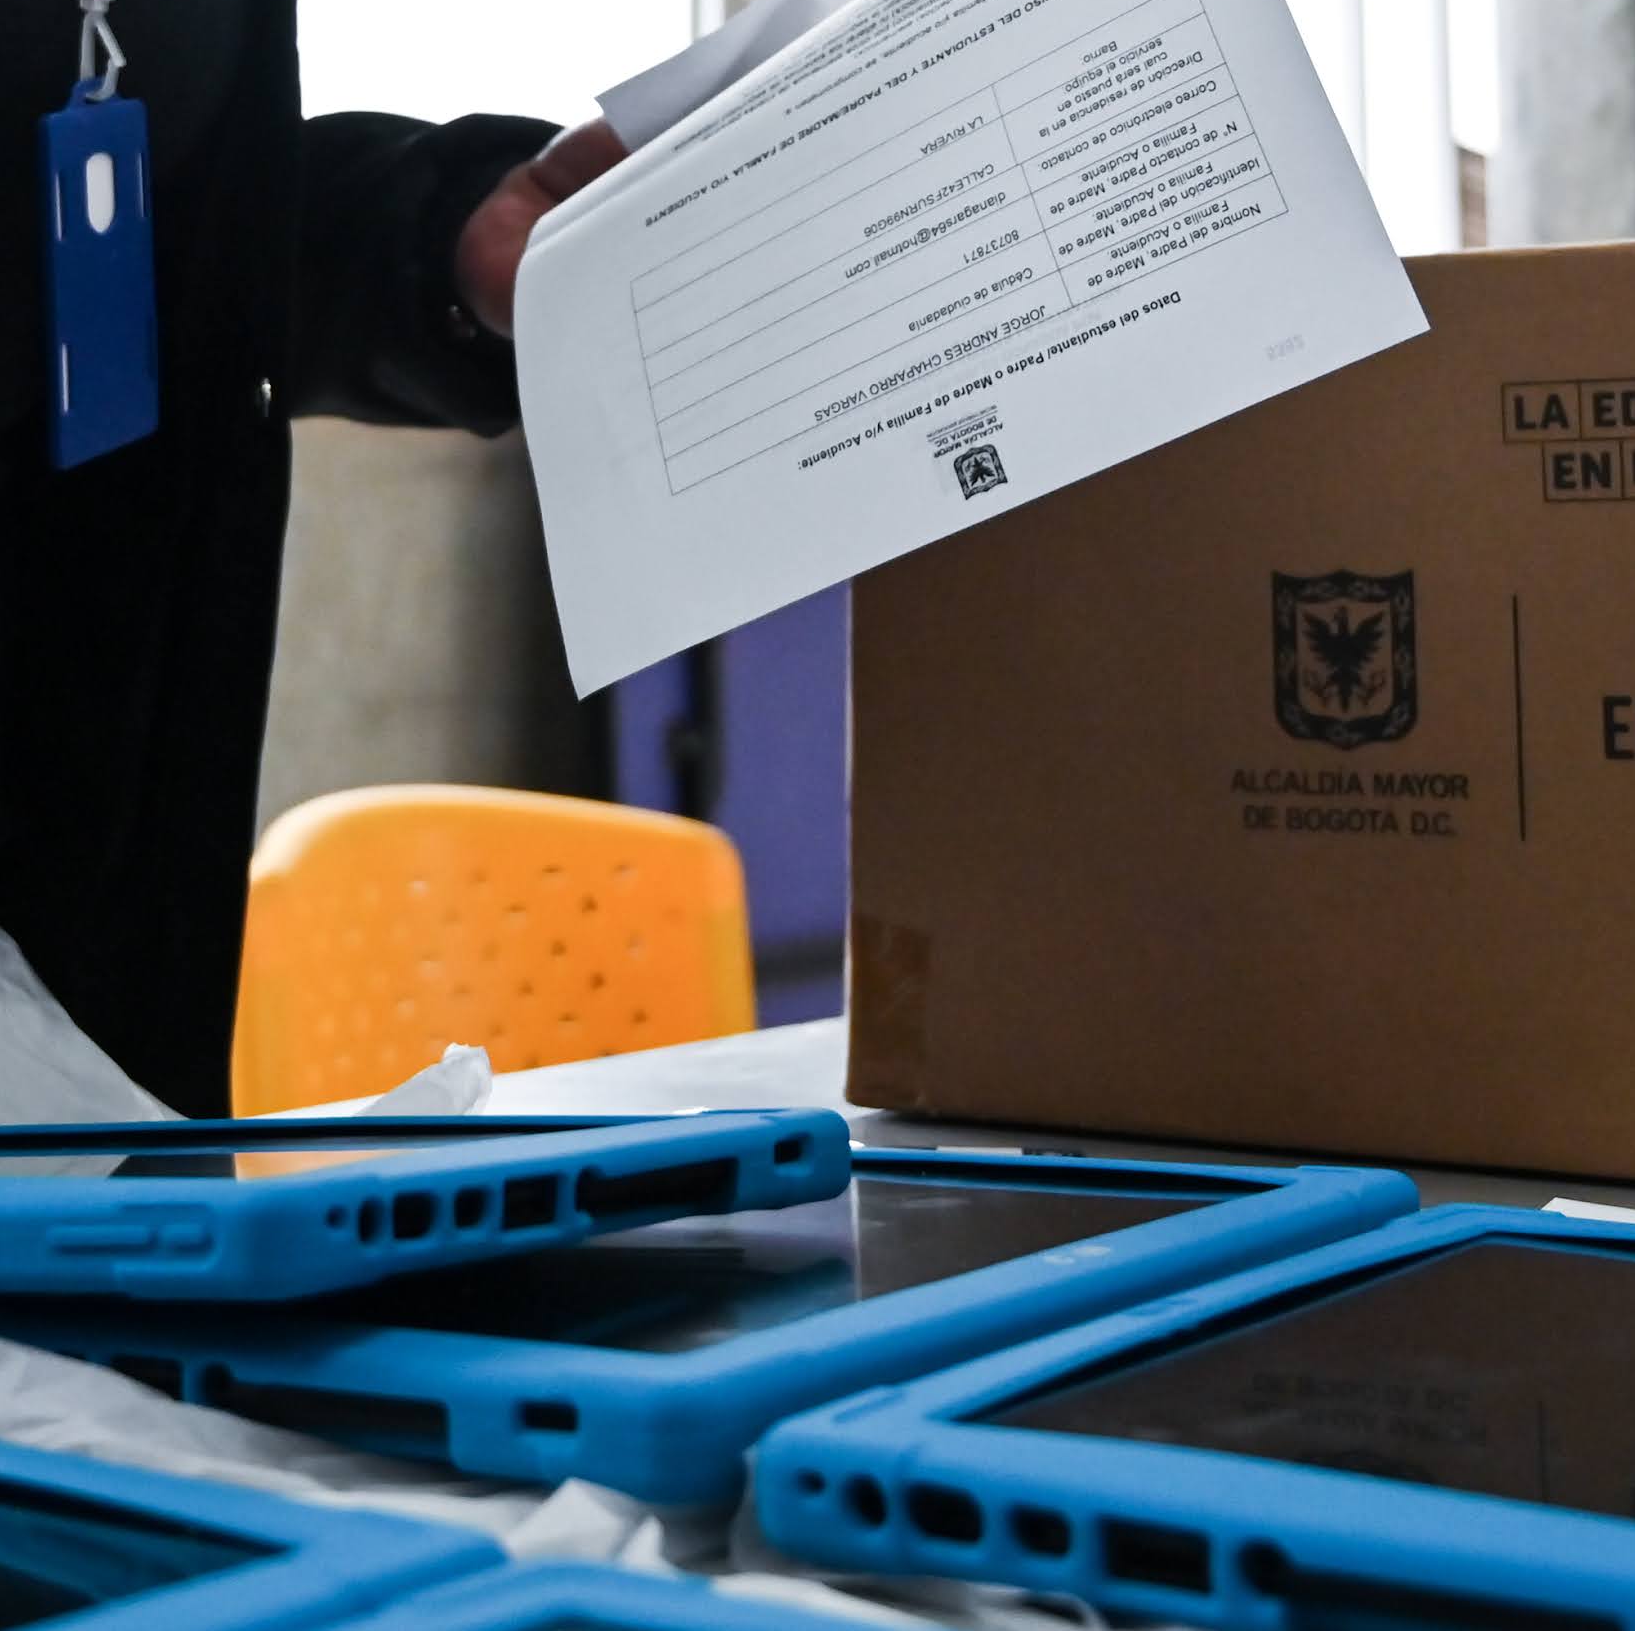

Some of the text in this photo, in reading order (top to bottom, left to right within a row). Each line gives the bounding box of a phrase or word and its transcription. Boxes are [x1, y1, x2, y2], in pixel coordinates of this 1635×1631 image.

[997, 8, 1022, 25] DEL
[921, 23, 995, 70] ESTUDIANTE
[1115, 34, 1163, 65] servicio
[911, 67, 919, 77] Y
[1102, 58, 1116, 74] el
[884, 72, 908, 89] DEL
[1057, 51, 1168, 112] cual será puesto en
[1175, 80, 1217, 105] Correo
[1039, 51, 1203, 137] Dirección de residencia en la
[1109, 100, 1173, 136] electrónico
[779, 136, 795, 151] DE
[920, 116, 984, 155] LA RIVERA
[1092, 132, 1107, 145] de
[1152, 122, 1197, 148] Familia
[1202, 130, 1218, 143] de
[733, 146, 776, 176] FAMILIA
[1142, 144, 1150, 153] o
[1149, 138, 1200, 167] contacto
[1107, 163, 1148, 185] Padre,
[1168, 161, 1213, 187] Familia
[1067, 182, 1106, 206] Madre
[1157, 182, 1166, 192] o
[645, 186, 708, 227] ACUDIENTE
[1050, 202, 1065, 214] de
[1058, 157, 1260, 256] Identificación del Padre, Madre de
[1183, 200, 1229, 226] Familia
[1172, 221, 1181, 231] o
[963, 229, 1020, 264] 80737871
[1087, 203, 1261, 287] Nombre del Padre, Madre de
[991, 267, 1033, 292] Cédula
[973, 288, 988, 300] de
[1142, 291, 1181, 314] Datos
[1119, 309, 1139, 327] del
[1047, 319, 1116, 359] estudiante/
[814, 305, 1045, 422] JORGE ANDRES CHAPARRO VARGAS
[995, 370, 1003, 379] o
[1006, 352, 1044, 374] Padre
[953, 375, 993, 398] Madre
[934, 394, 950, 407] de
[1513, 392, 1569, 431] LA
[886, 402, 932, 429] Familia
[865, 421, 884, 439] y/o
[798, 434, 861, 470] Acudiente:
[1551, 450, 1612, 491] EN
[1229, 765, 1471, 801] ALCALDÍA MAYOR
[1242, 804, 1278, 831] DE
